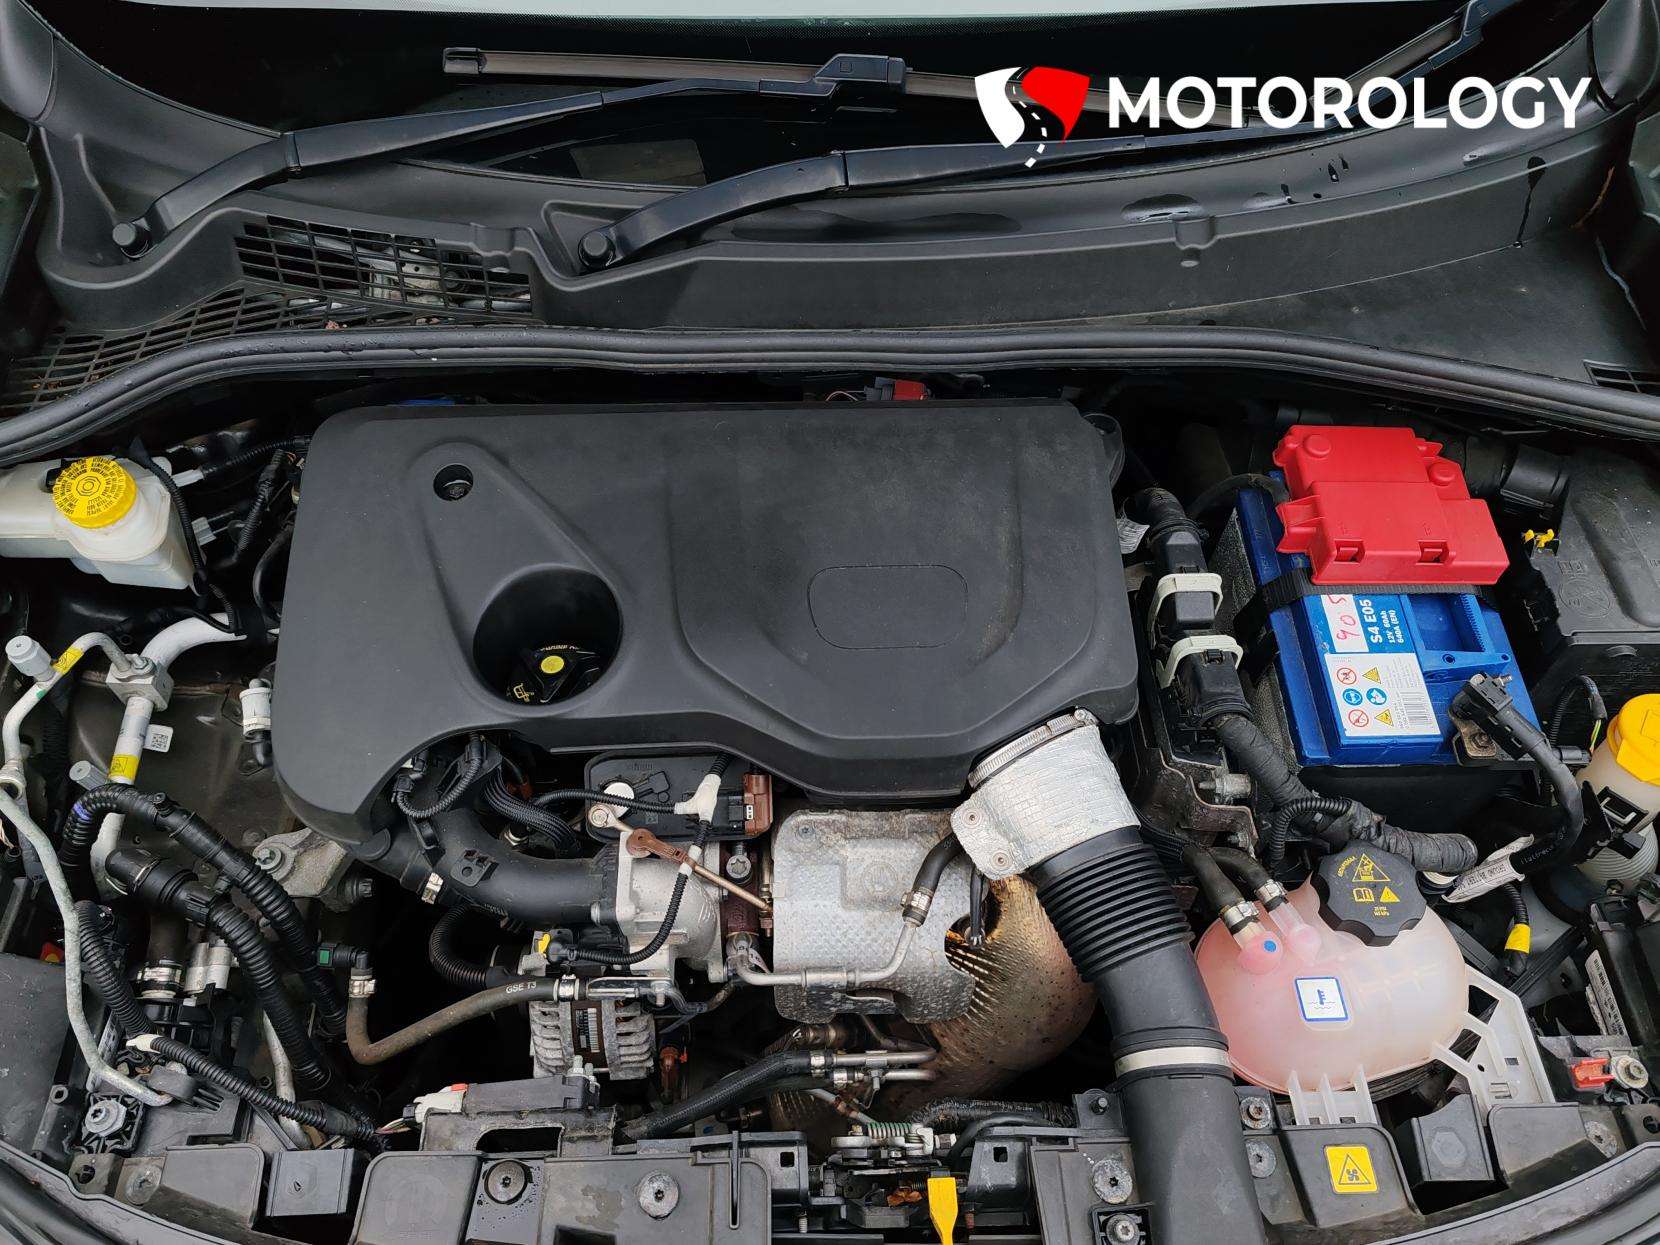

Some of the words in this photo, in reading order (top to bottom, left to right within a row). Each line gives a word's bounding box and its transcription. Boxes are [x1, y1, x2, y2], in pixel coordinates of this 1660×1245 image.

[1360, 599, 1377, 623] E05
[1380, 610, 1391, 628] 60Ah
[1388, 609, 1399, 625] (EN)
[1368, 626, 1383, 643] S4
[1386, 630, 1396, 644] 12V
[1393, 625, 1404, 644] 640A
[505, 982, 525, 994] GSE
